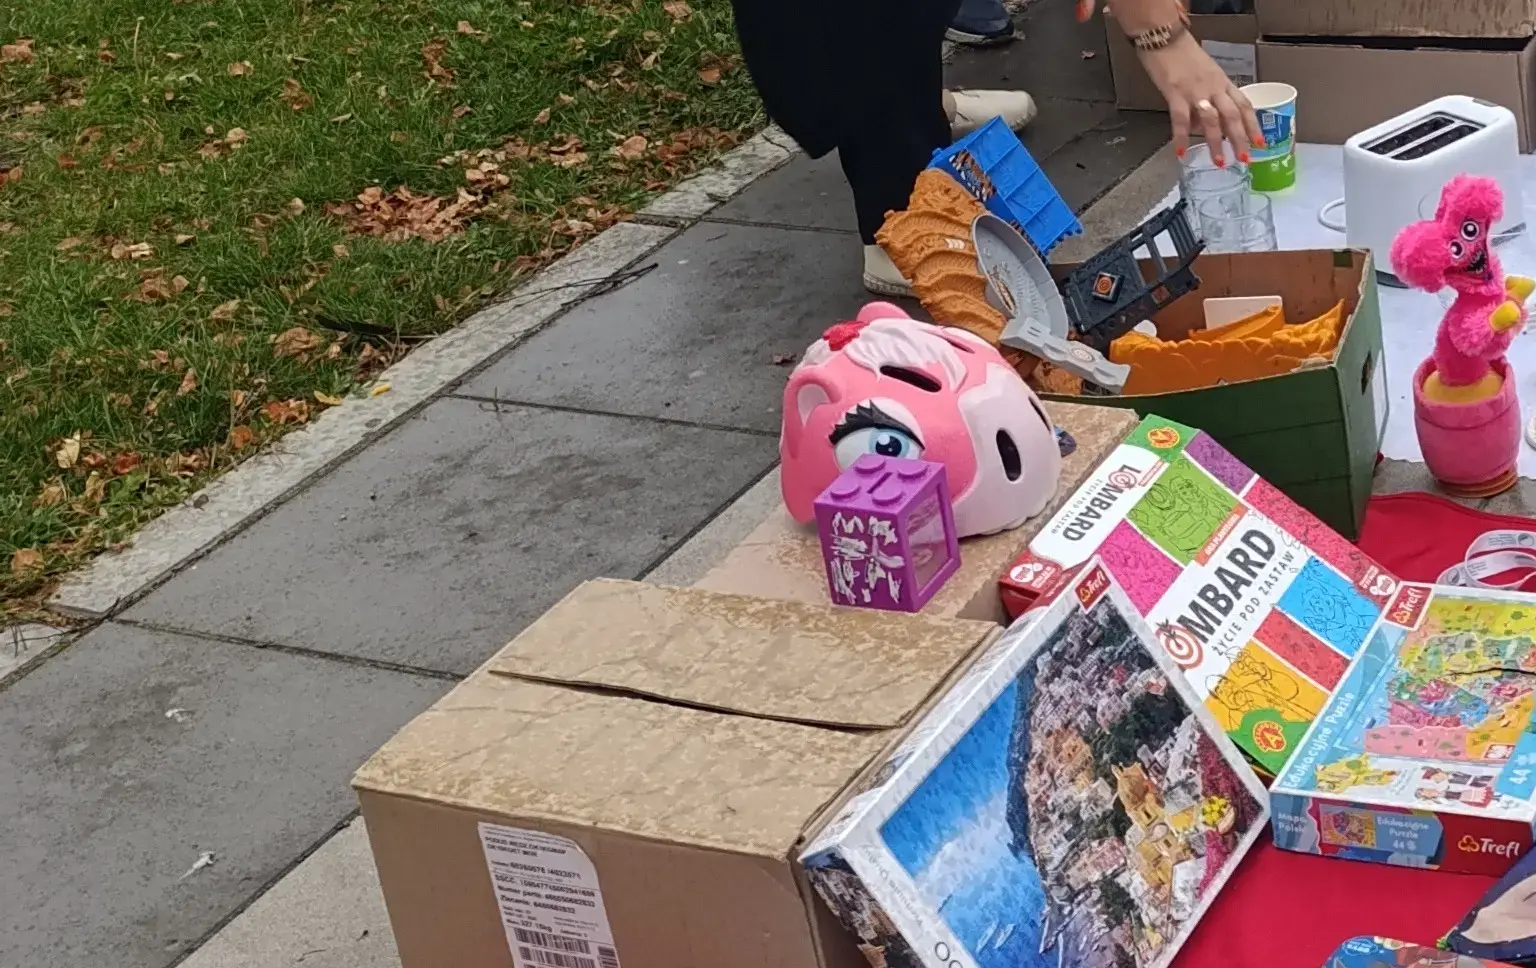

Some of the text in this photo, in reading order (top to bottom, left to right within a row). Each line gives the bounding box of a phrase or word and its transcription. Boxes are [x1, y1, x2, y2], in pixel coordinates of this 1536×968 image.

[1062, 463, 1142, 542] LOMBARD
[1086, 569, 1106, 595] Trefl
[1155, 528, 1277, 668] OMBARD
[1210, 550, 1296, 656] ŻYCIE POD ZASTAW
[1397, 587, 1422, 615] Trefl
[1283, 692, 1355, 787] Edukacyjne Puzzle
[1508, 769, 1532, 785] 44
[1278, 813, 1306, 824] Mapa
[1389, 828, 1419, 840] Puzzle
[1480, 837, 1521, 857] Trefl
